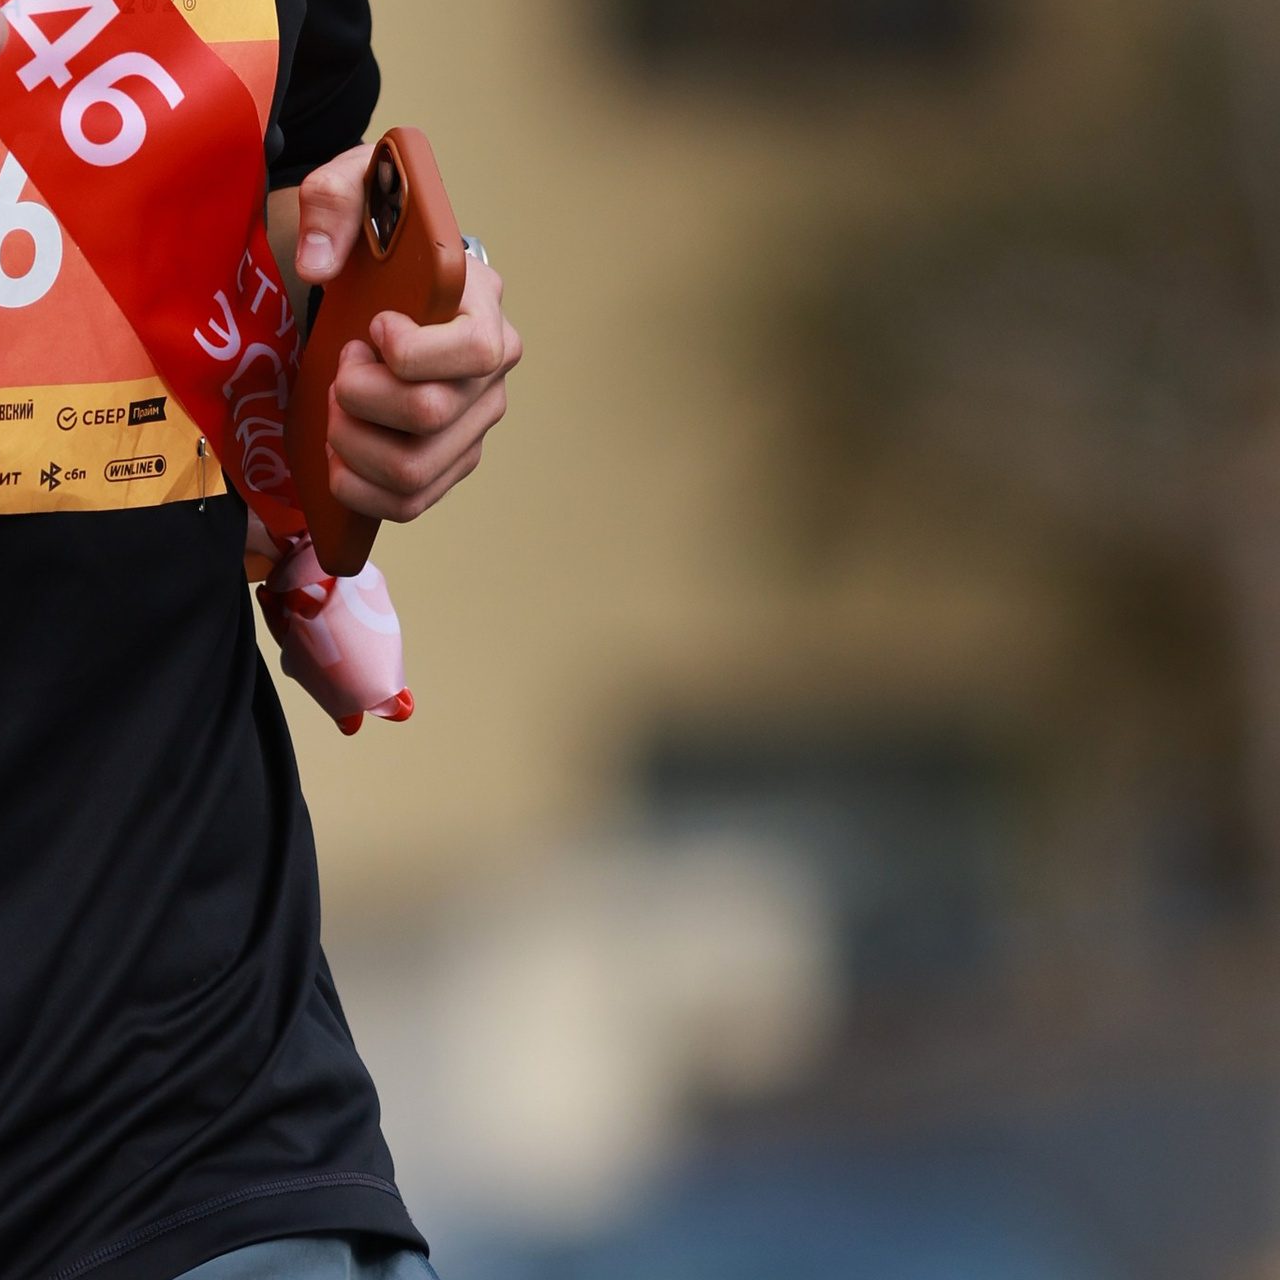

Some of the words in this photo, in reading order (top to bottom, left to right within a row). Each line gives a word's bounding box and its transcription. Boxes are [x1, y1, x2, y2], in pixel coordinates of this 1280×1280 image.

[83, 408, 126, 426] СБЕР
[133, 403, 159, 422] Прайм
[64, 467, 86, 481] сбп
[109, 459, 153, 478] WINLINE
